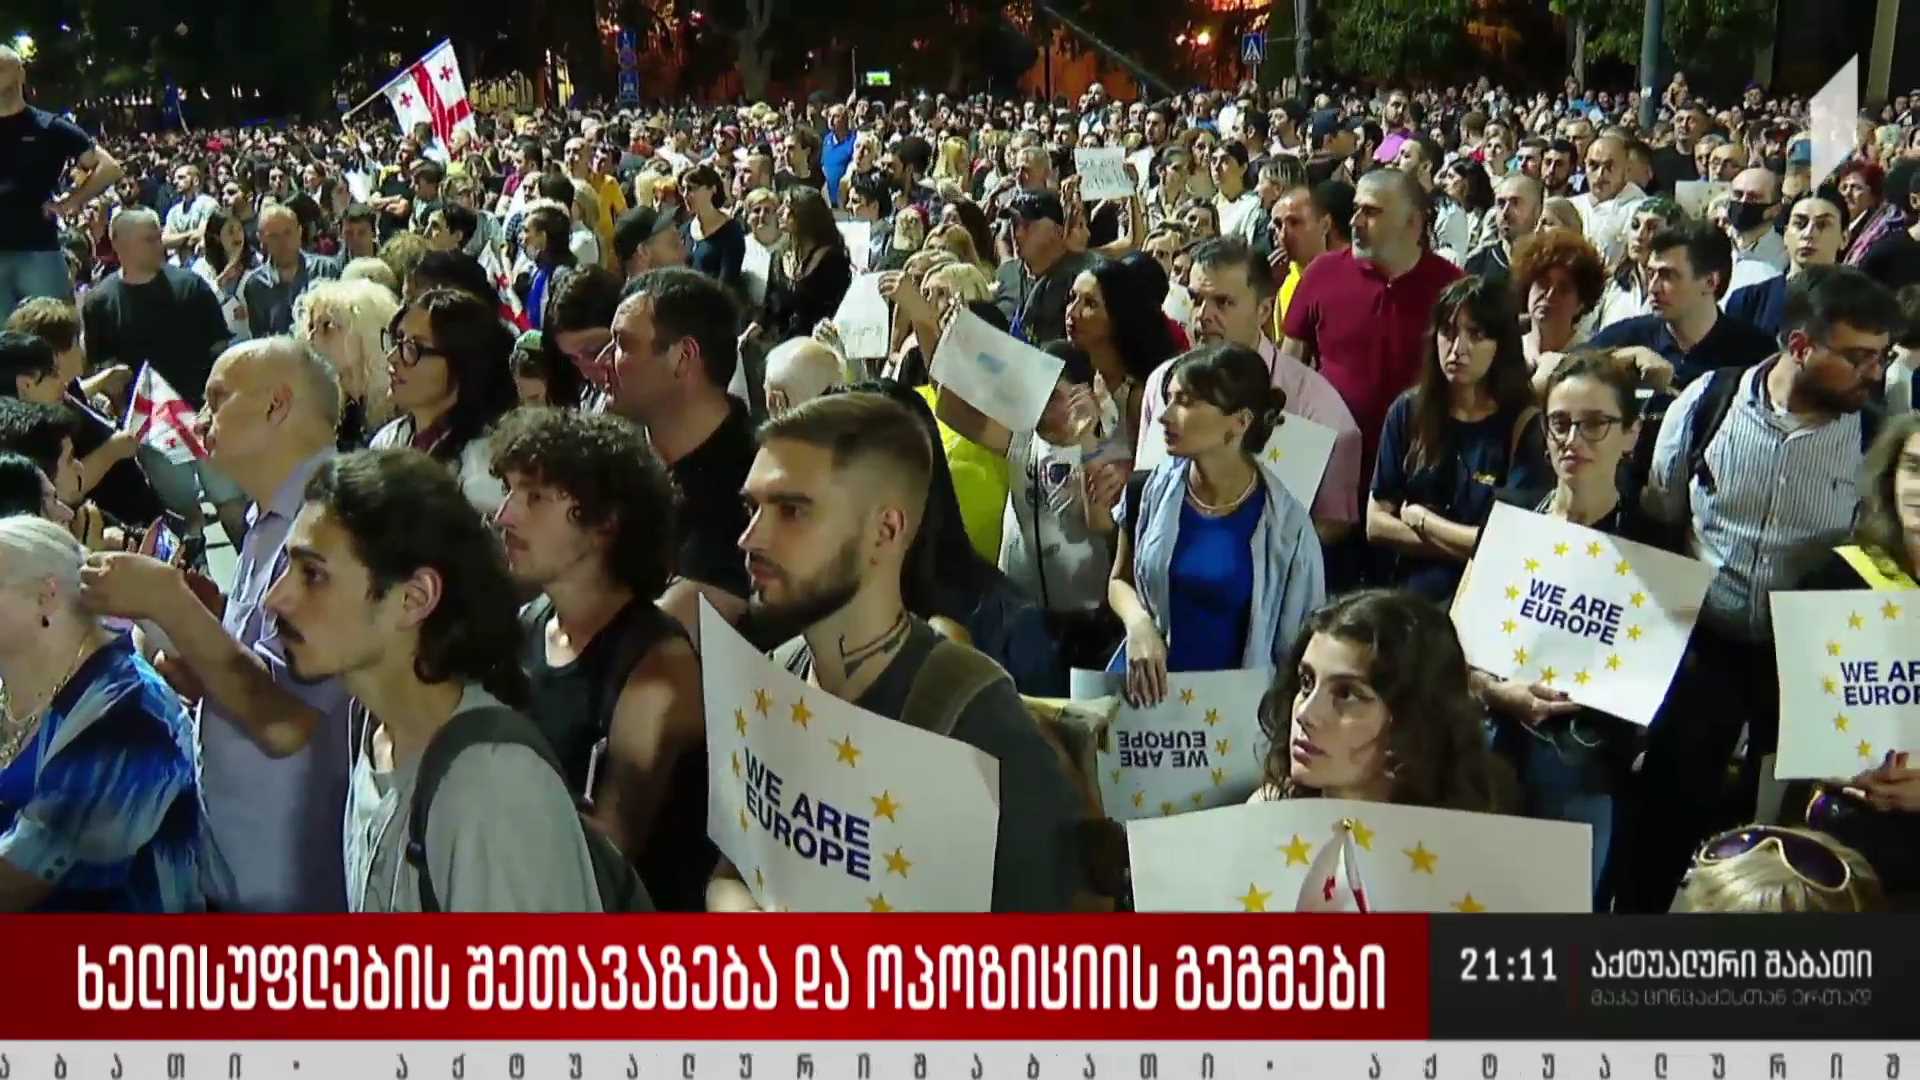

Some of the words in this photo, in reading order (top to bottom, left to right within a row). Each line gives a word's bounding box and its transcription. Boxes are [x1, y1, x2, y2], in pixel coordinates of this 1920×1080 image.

[1529, 577, 1567, 606] WE
[1570, 593, 1624, 625] ARE
[1519, 598, 1619, 646] EUROPE
[1840, 661, 1879, 683] WE
[1117, 730, 1206, 749] EUROPE
[1120, 750, 1163, 768] ARE
[1172, 750, 1209, 768] WE
[744, 746, 784, 808] WE
[791, 791, 871, 850] ARE
[744, 781, 871, 882] EUROPE
